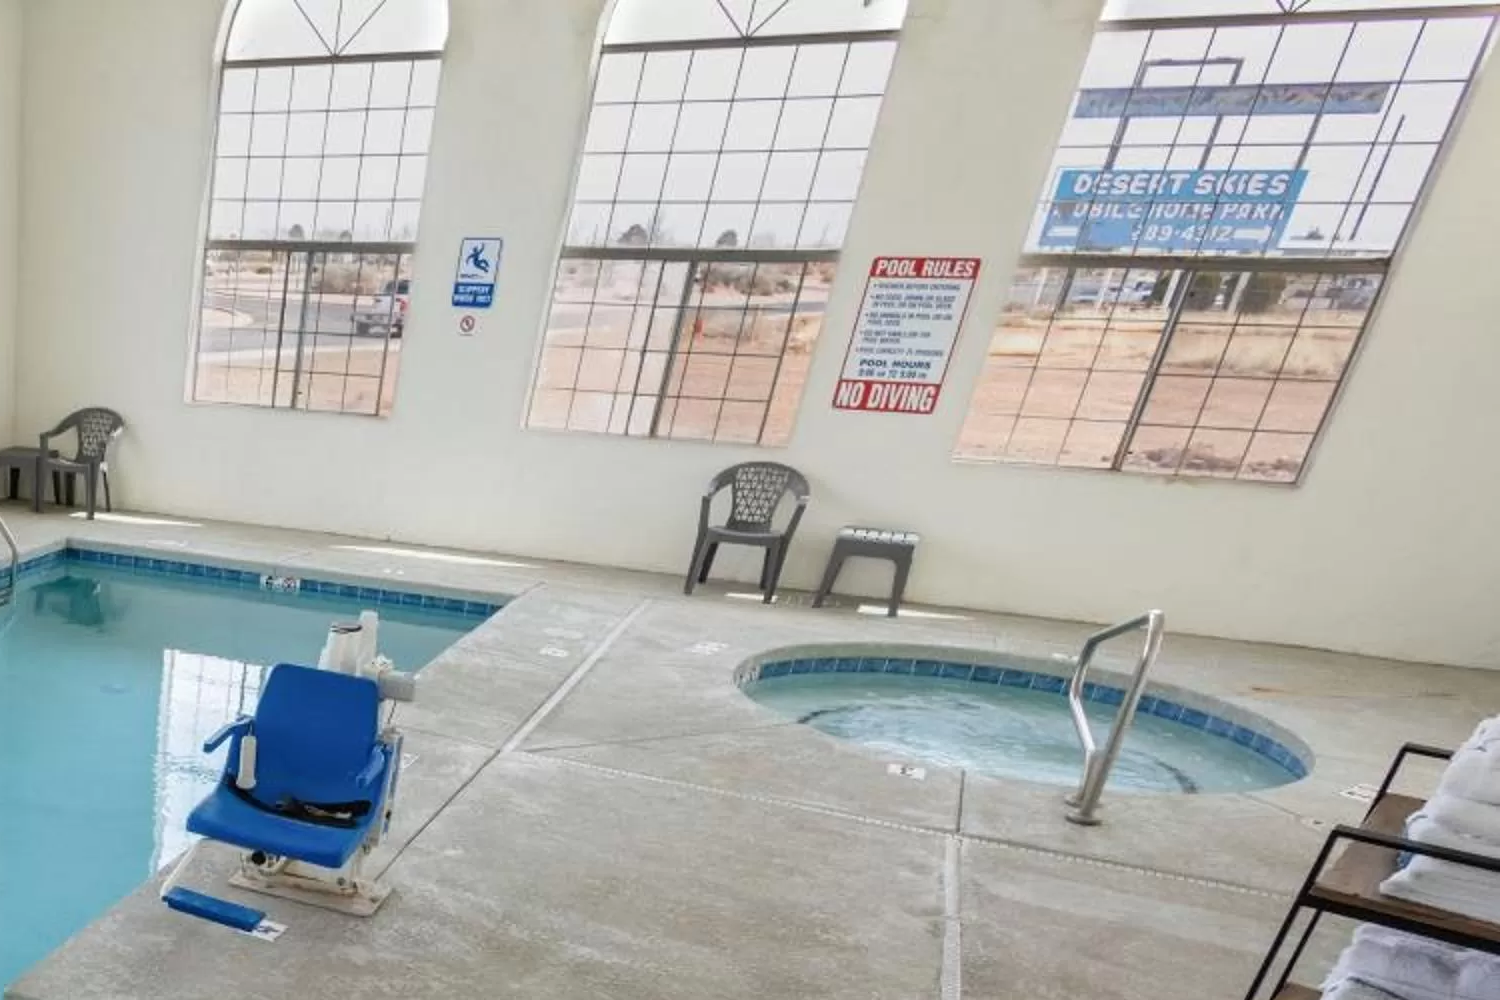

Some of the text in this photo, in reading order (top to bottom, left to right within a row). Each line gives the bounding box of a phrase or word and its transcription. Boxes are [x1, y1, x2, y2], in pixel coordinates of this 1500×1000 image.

[1073, 173, 1291, 196] DESERT SKIES
[875, 259, 976, 277] POOL RULES
[859, 359, 931, 369] POOL HOURS
[836, 382, 936, 411] NO DIVING
